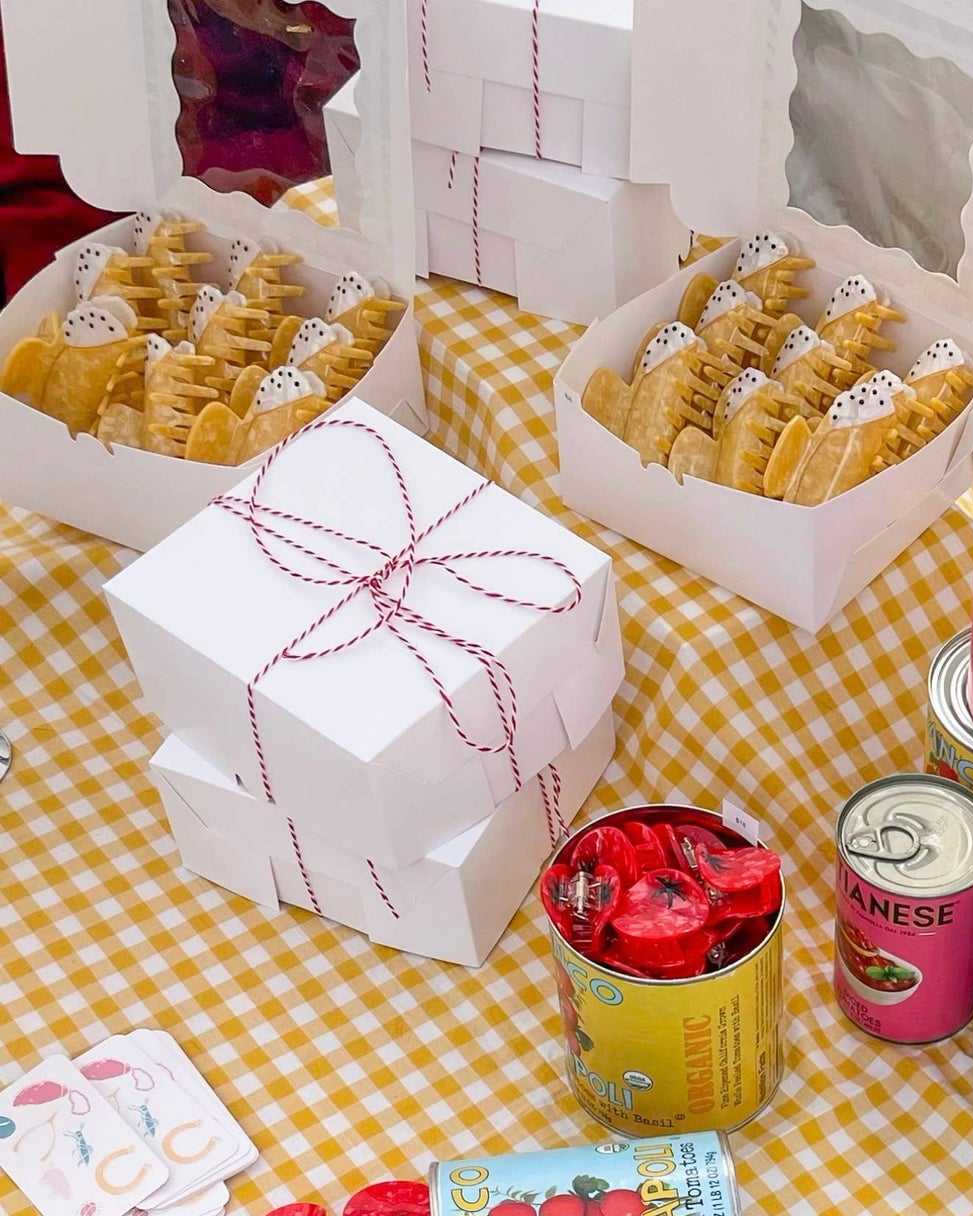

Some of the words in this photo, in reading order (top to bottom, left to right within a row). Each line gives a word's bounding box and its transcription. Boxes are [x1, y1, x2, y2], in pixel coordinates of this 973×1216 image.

[682, 1014, 715, 1115] ORGANIC
[633, 1113, 676, 1128] Basil
[705, 1150, 718, 1167] 794g
[679, 1142, 705, 1212] Tomatoes
[710, 1178, 721, 1190] 12
[710, 1189, 723, 1202] LB
